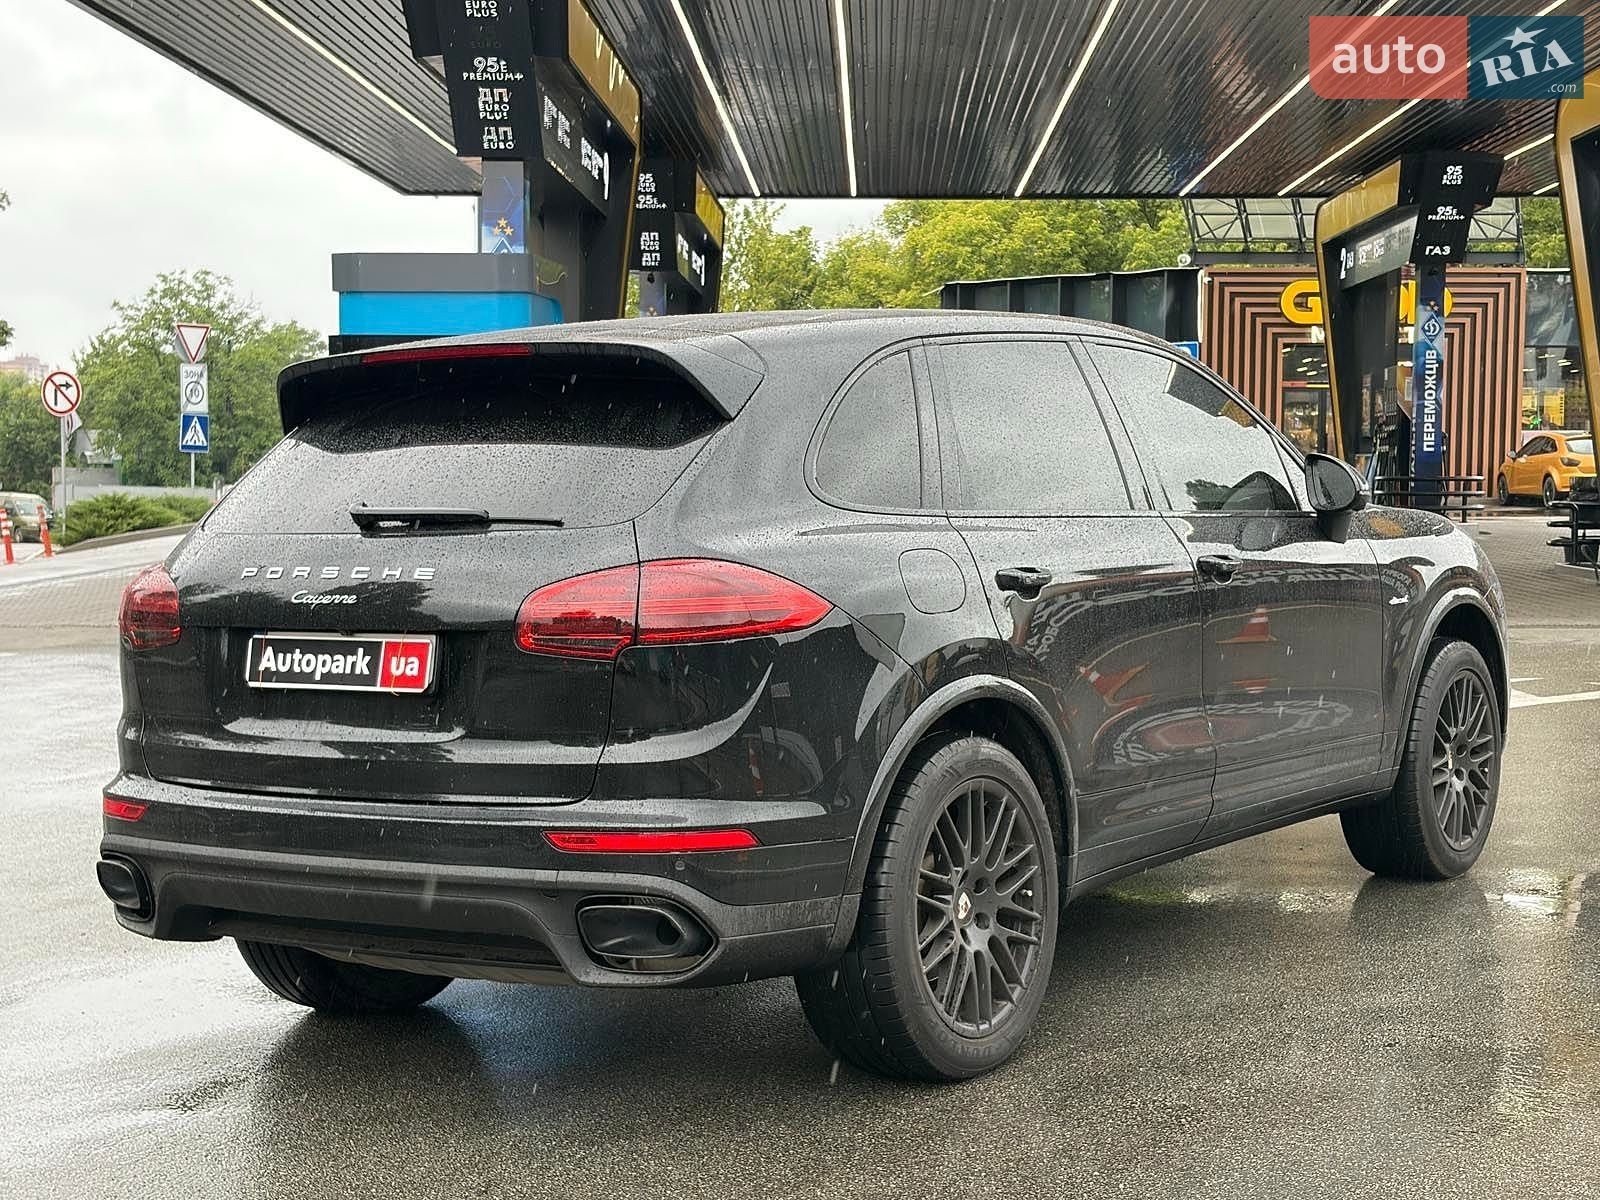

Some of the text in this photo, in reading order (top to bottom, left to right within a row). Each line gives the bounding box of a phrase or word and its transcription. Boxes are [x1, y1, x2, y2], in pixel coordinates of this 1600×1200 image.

[465, 0, 498, 9] EURO
[466, 8, 498, 17] PLUS
[473, 57, 508, 73] 95E
[462, 72, 524, 80] PREMIUM+
[479, 103, 510, 111] EURO
[1446, 165, 1463, 175] 95
[639, 173, 654, 183] 95
[1425, 246, 1451, 256] ГАЗ
[1422, 349, 1439, 452] ПЕРЕМОЖЦІВ
[240, 566, 436, 581] PORSCHE
[291, 590, 358, 610] Cayenne
[258, 646, 420, 681] Autopark ua
